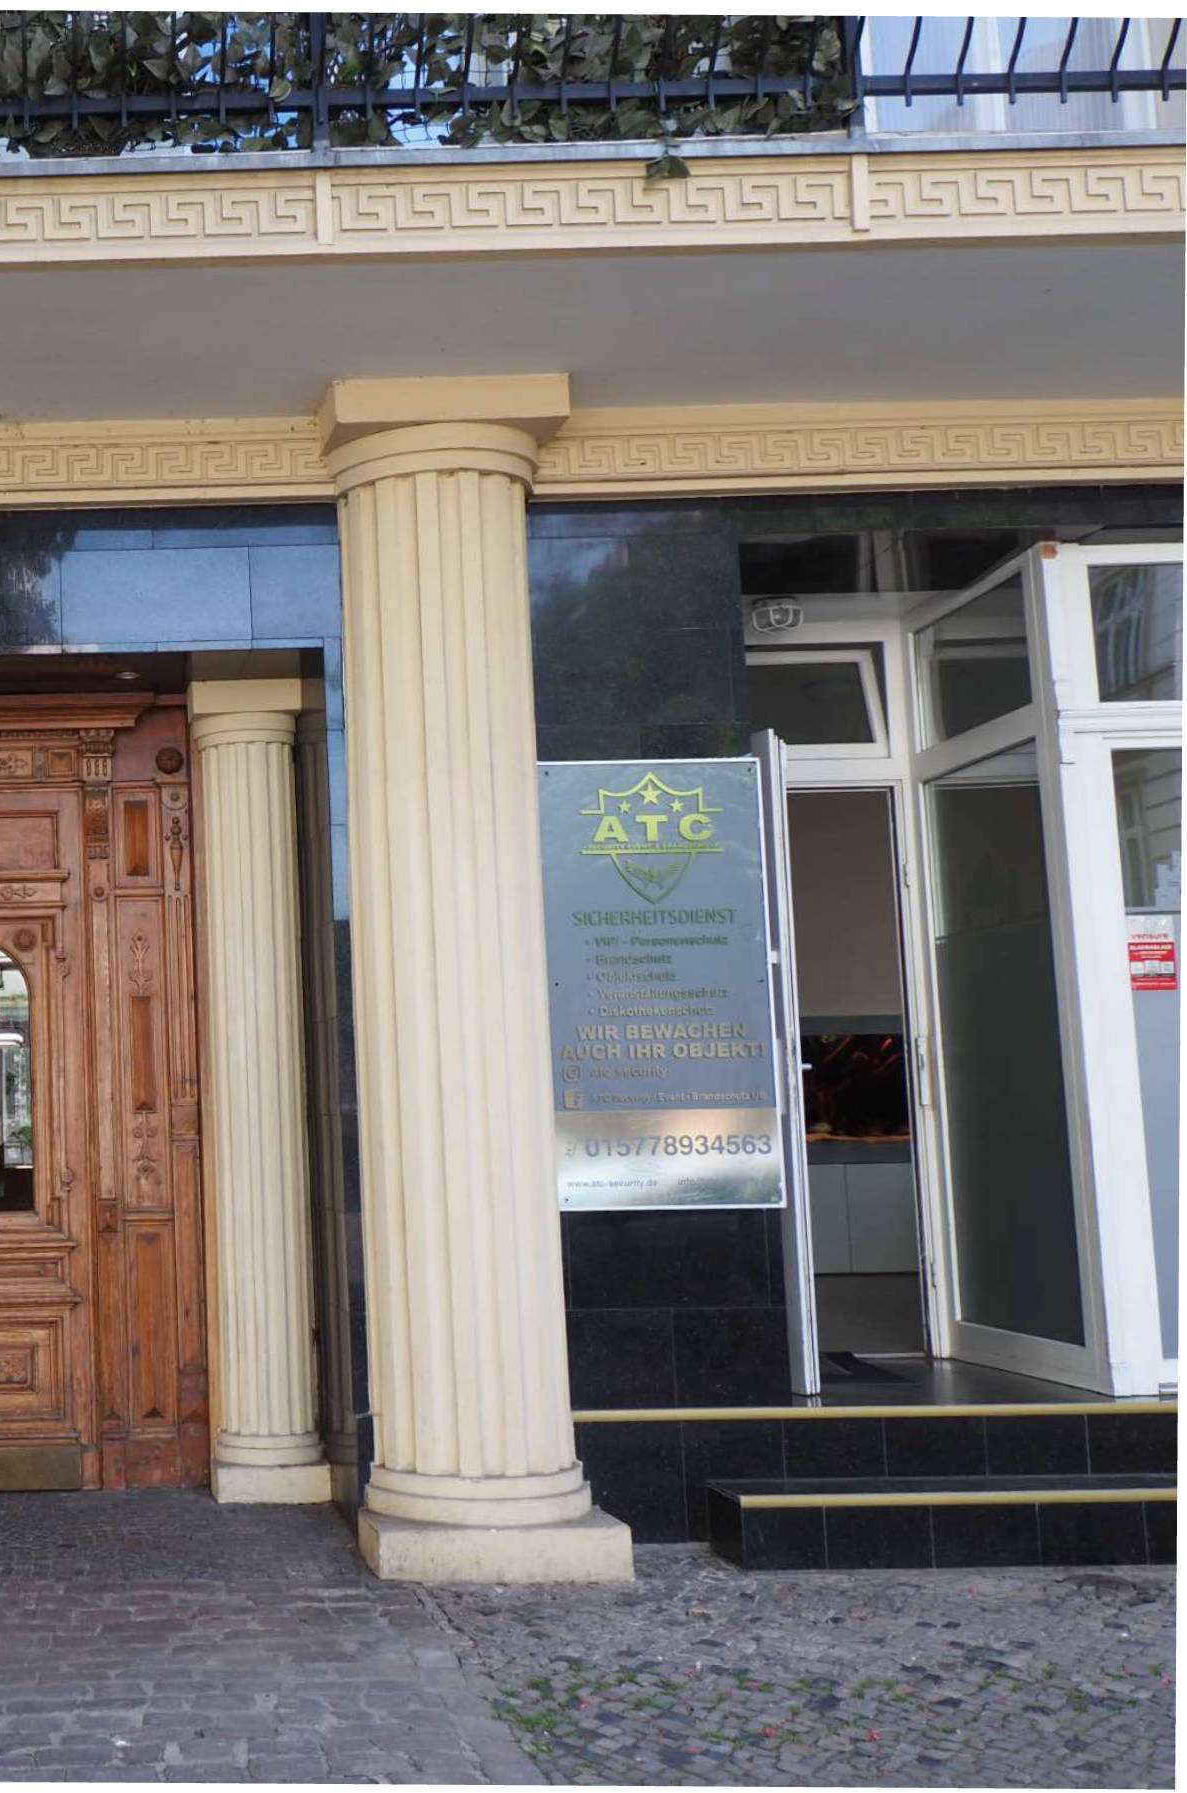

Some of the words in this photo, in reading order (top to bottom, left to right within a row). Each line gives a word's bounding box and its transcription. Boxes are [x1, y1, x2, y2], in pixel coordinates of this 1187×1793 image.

[593, 813, 711, 842] ATC
[572, 908, 735, 926] SICHERHEITSDIENST
[577, 1025, 620, 1041] WIR
[625, 1022, 747, 1040] BEWACHEN
[561, 1044, 622, 1061] AUCH
[629, 1043, 667, 1059] IHR
[673, 1041, 765, 1059] OBJEKT!
[584, 1134, 773, 1157] 015778934563
